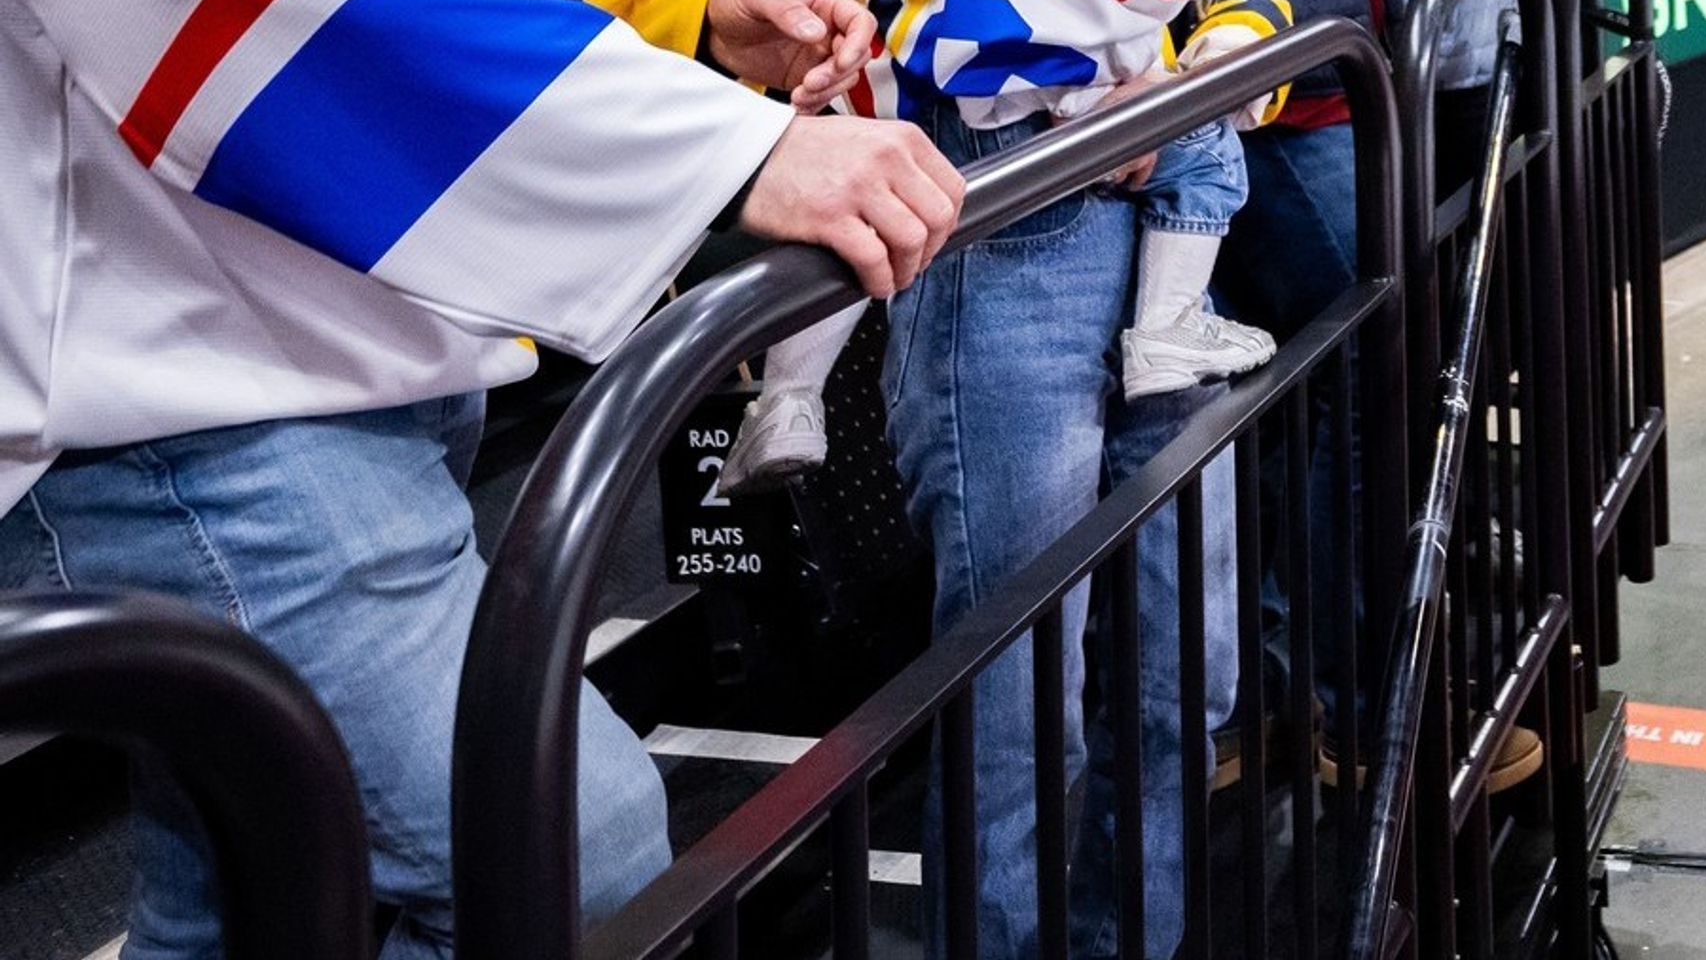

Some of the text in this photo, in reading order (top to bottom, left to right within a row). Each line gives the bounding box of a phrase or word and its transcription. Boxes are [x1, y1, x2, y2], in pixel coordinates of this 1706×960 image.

[689, 429, 729, 448] RAD
[697, 456, 731, 507] 2
[691, 527, 744, 545] PLATS
[677, 554, 762, 575] 255-240
[1670, 729, 1704, 746] IN
